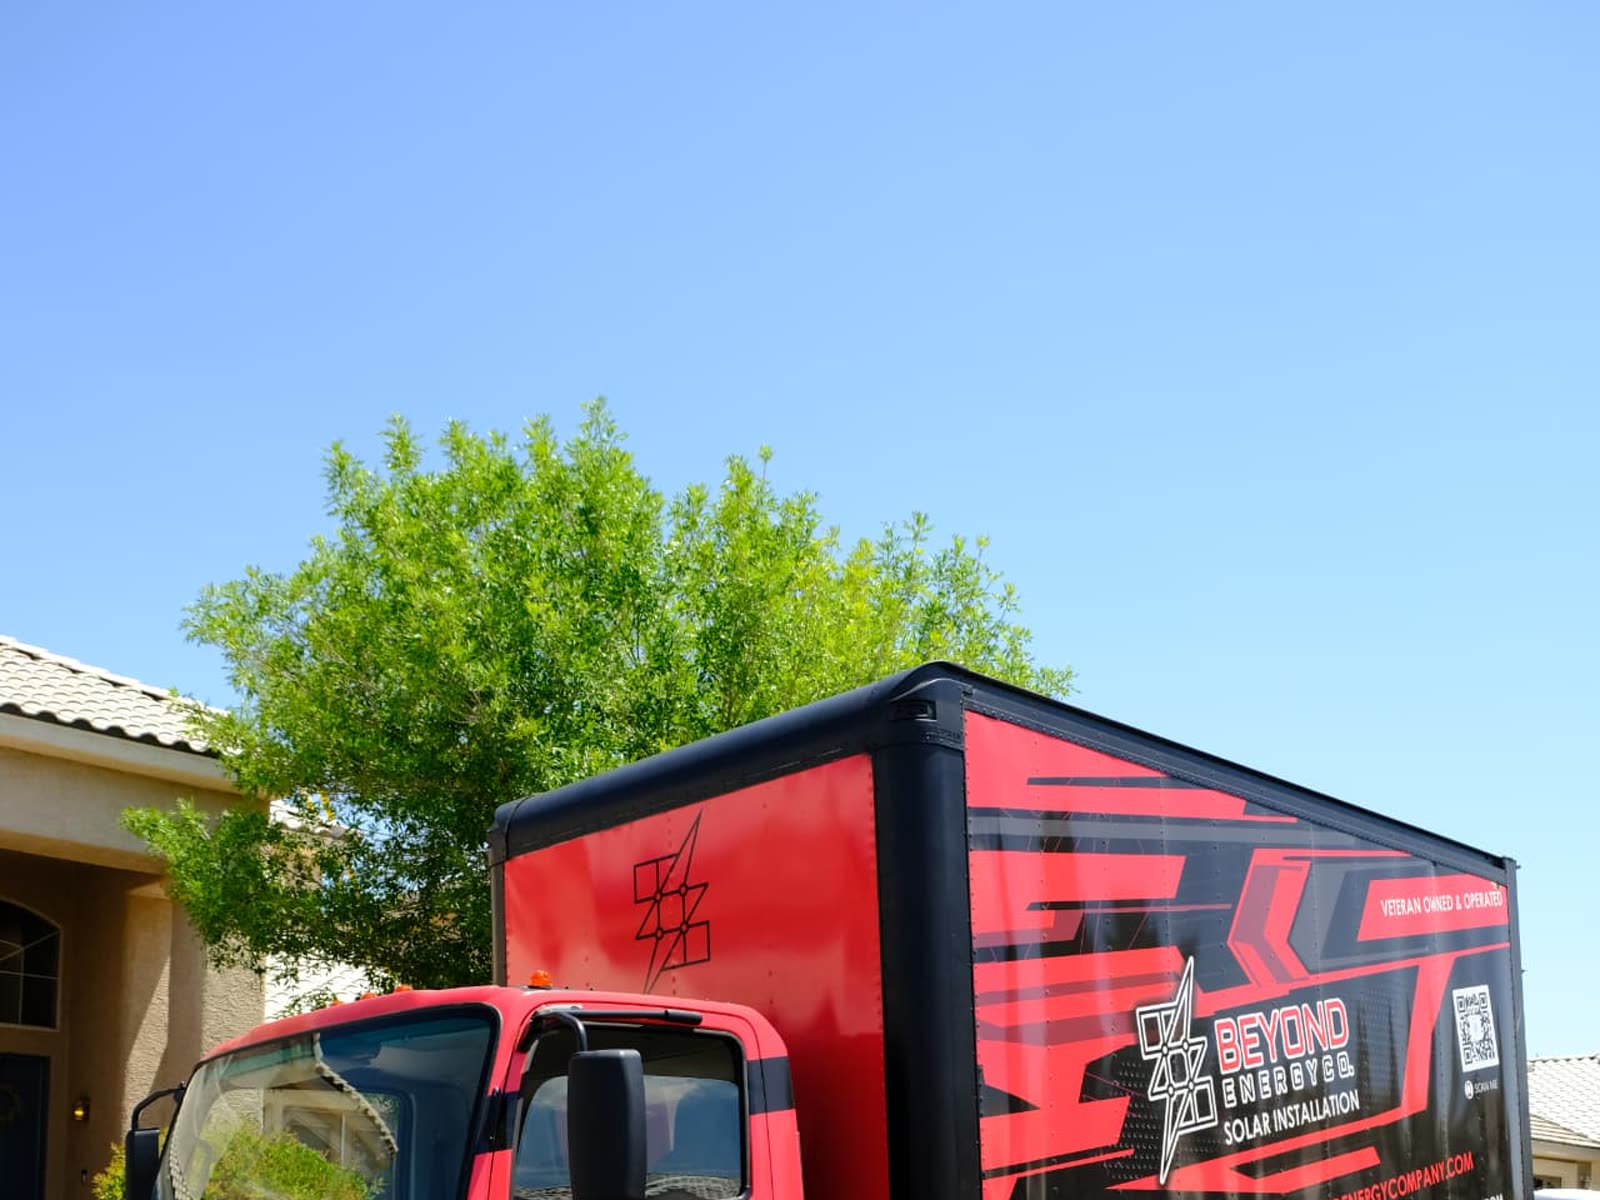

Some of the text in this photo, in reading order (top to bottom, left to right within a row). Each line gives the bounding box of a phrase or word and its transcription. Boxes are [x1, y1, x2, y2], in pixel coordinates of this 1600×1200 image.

[1380, 890, 1503, 917] VETERAN OWNED & OPERATED
[1214, 998, 1350, 1075] BEYOND
[1223, 1089, 1361, 1146] SOLAR INSTALLATION
